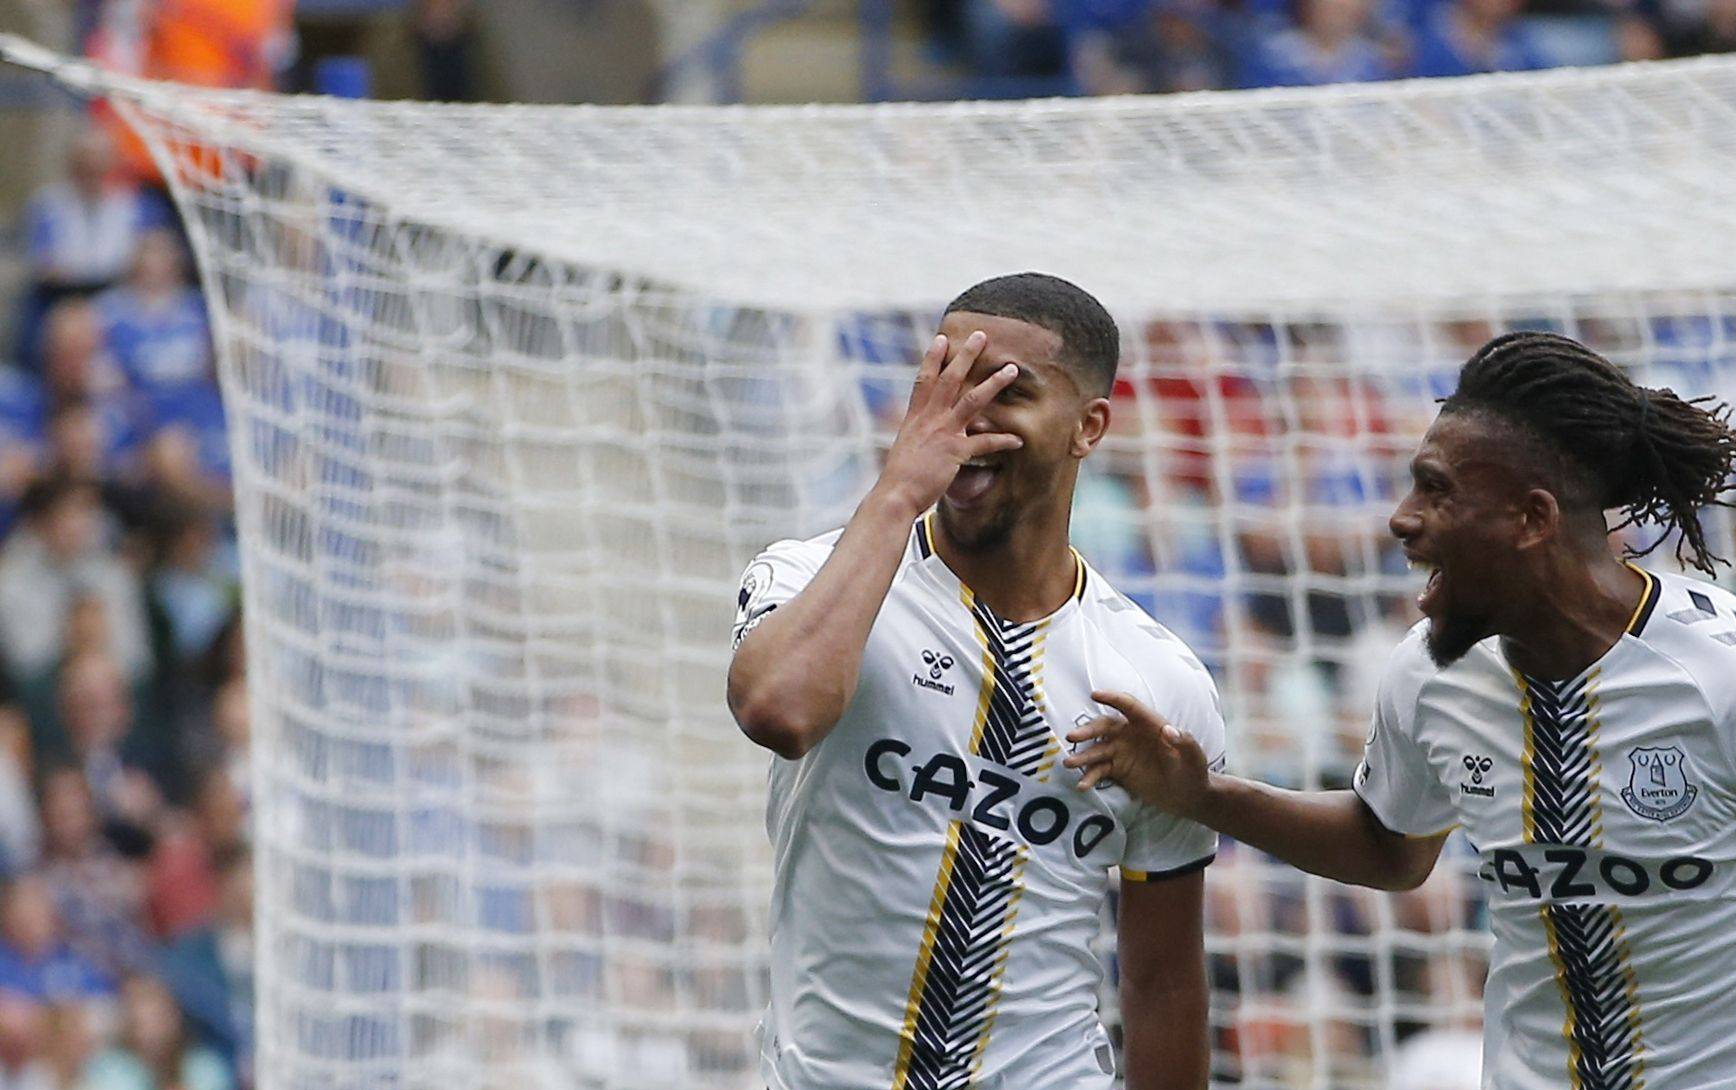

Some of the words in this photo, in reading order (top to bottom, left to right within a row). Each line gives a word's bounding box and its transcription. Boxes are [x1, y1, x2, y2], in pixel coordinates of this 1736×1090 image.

[913, 674, 955, 696] hummel
[863, 738, 1114, 858] CAZOO
[1641, 787, 1678, 798] Everton
[1477, 848, 1714, 898] AZOO
